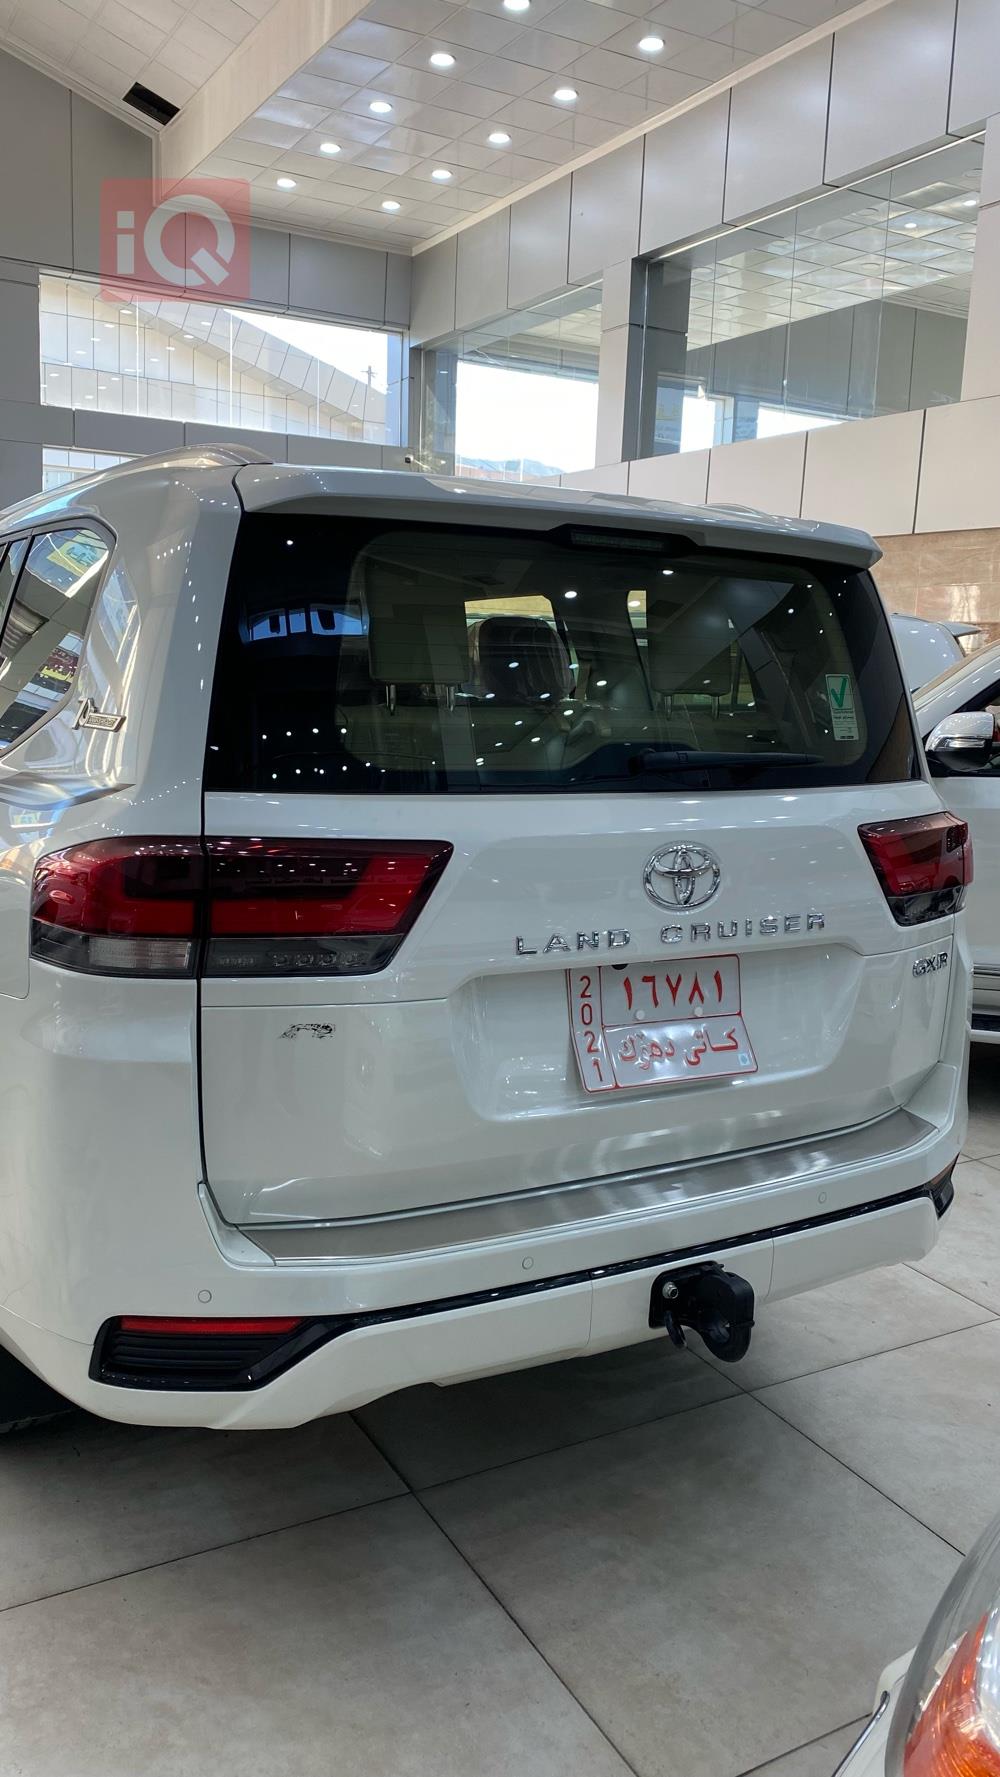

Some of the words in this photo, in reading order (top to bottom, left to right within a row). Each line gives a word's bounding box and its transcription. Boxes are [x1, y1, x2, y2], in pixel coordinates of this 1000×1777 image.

[515, 928, 632, 955] LAND
[660, 912, 827, 945] CRUISER
[912, 951, 948, 977] GXR
[623, 970, 723, 1011] ١٦٧٨١
[579, 975, 604, 1082] 2021
